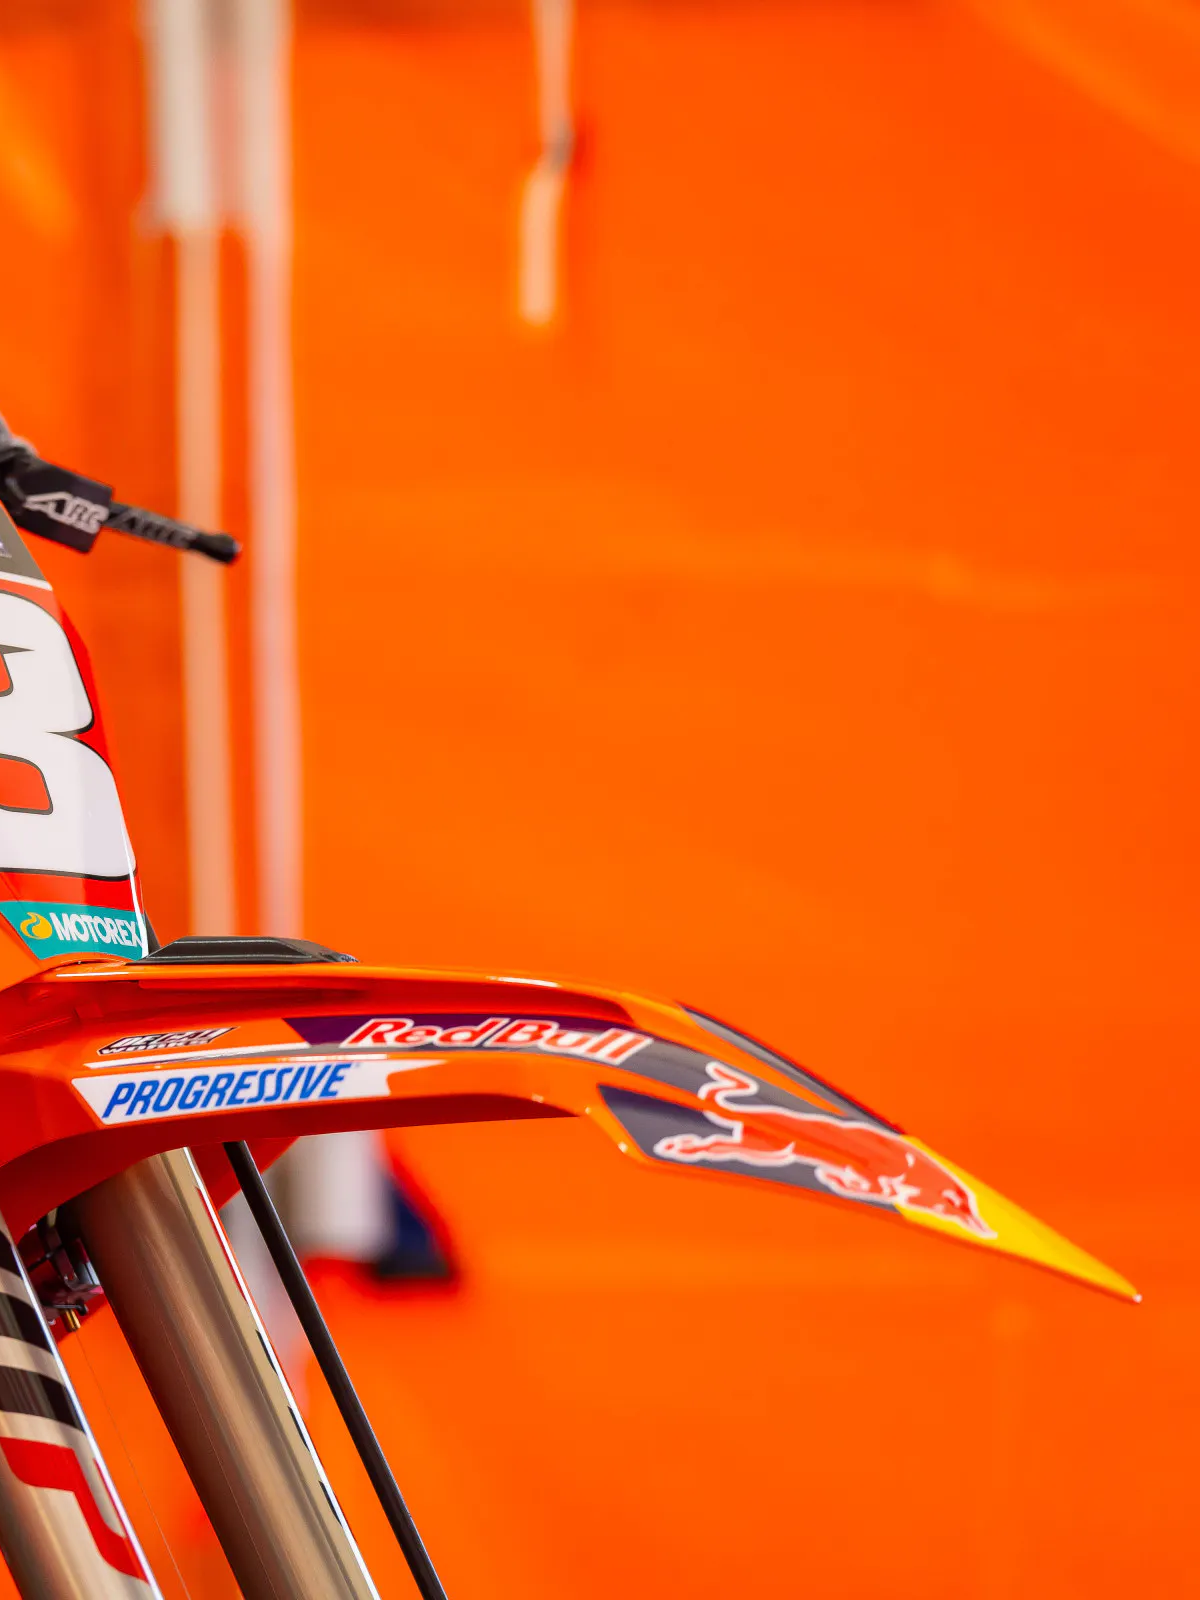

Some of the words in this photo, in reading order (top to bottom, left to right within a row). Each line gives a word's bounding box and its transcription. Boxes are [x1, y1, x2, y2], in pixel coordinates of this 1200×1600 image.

[23, 491, 109, 535] ARC
[49, 912, 143, 948] MOTOREX
[340, 1017, 510, 1049] Red
[483, 1019, 654, 1066] Bull
[101, 1062, 352, 1119] PROGRESSIVE
